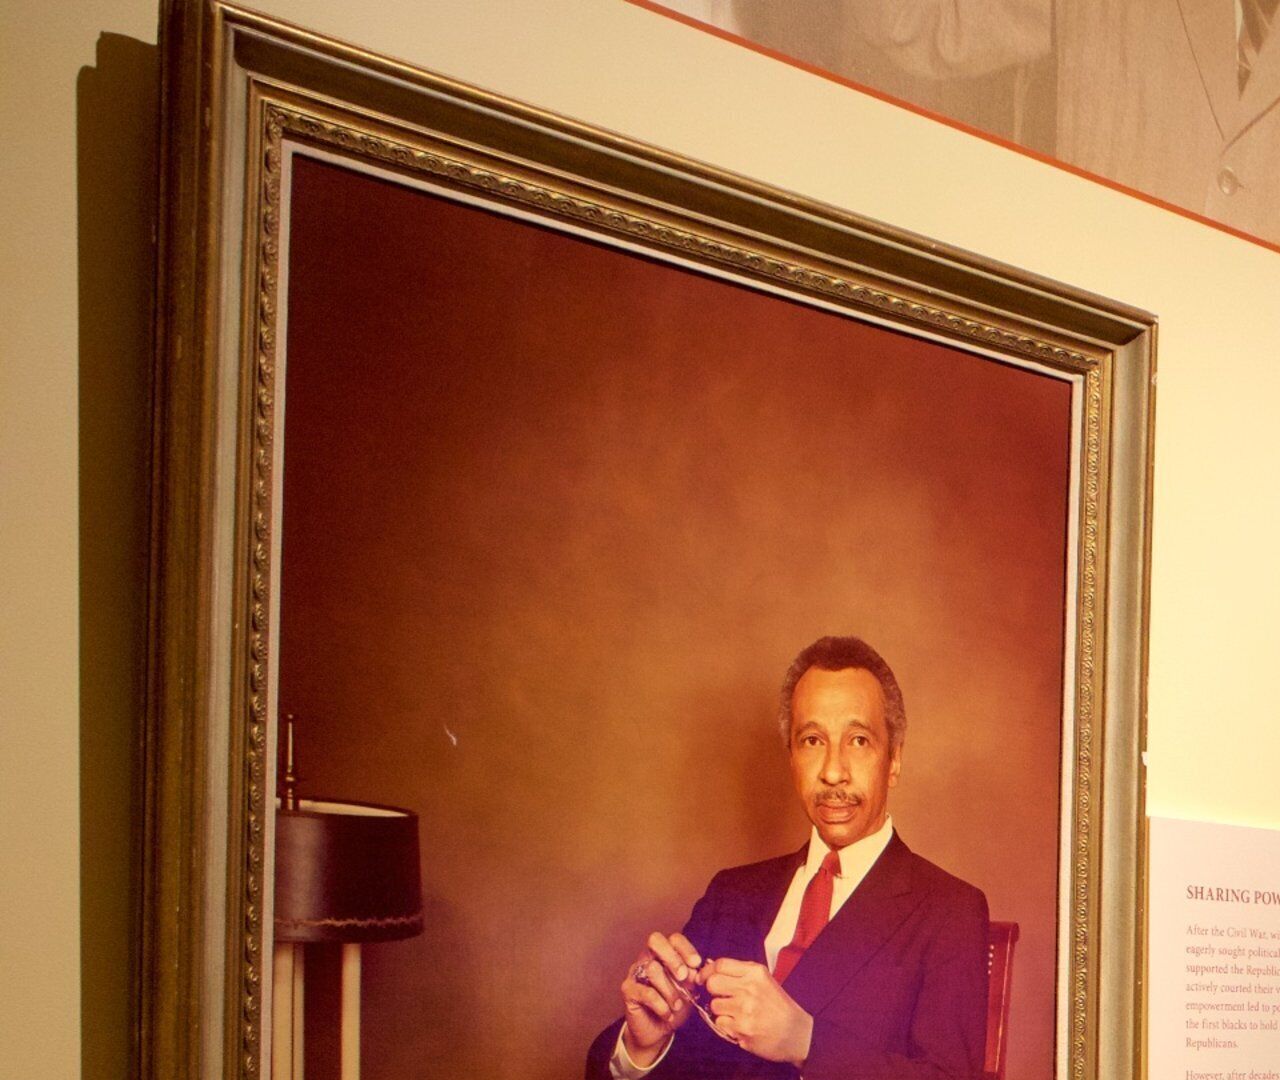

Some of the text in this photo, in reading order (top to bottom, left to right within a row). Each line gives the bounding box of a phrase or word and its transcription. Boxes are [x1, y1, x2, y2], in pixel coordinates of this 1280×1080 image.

[1186, 885, 1250, 903] SHARING
[1186, 924, 1208, 936] After
[1210, 925, 1224, 936] the
[1226, 927, 1246, 938] Civil
[1185, 943, 1215, 957] eagerly
[1218, 945, 1245, 959] sought
[1247, 946, 1280, 959] political
[1186, 964, 1228, 976] supported
[1230, 963, 1244, 974] the
[1226, 1069, 1246, 1080] after
[1248, 1069, 1279, 1080] decades
